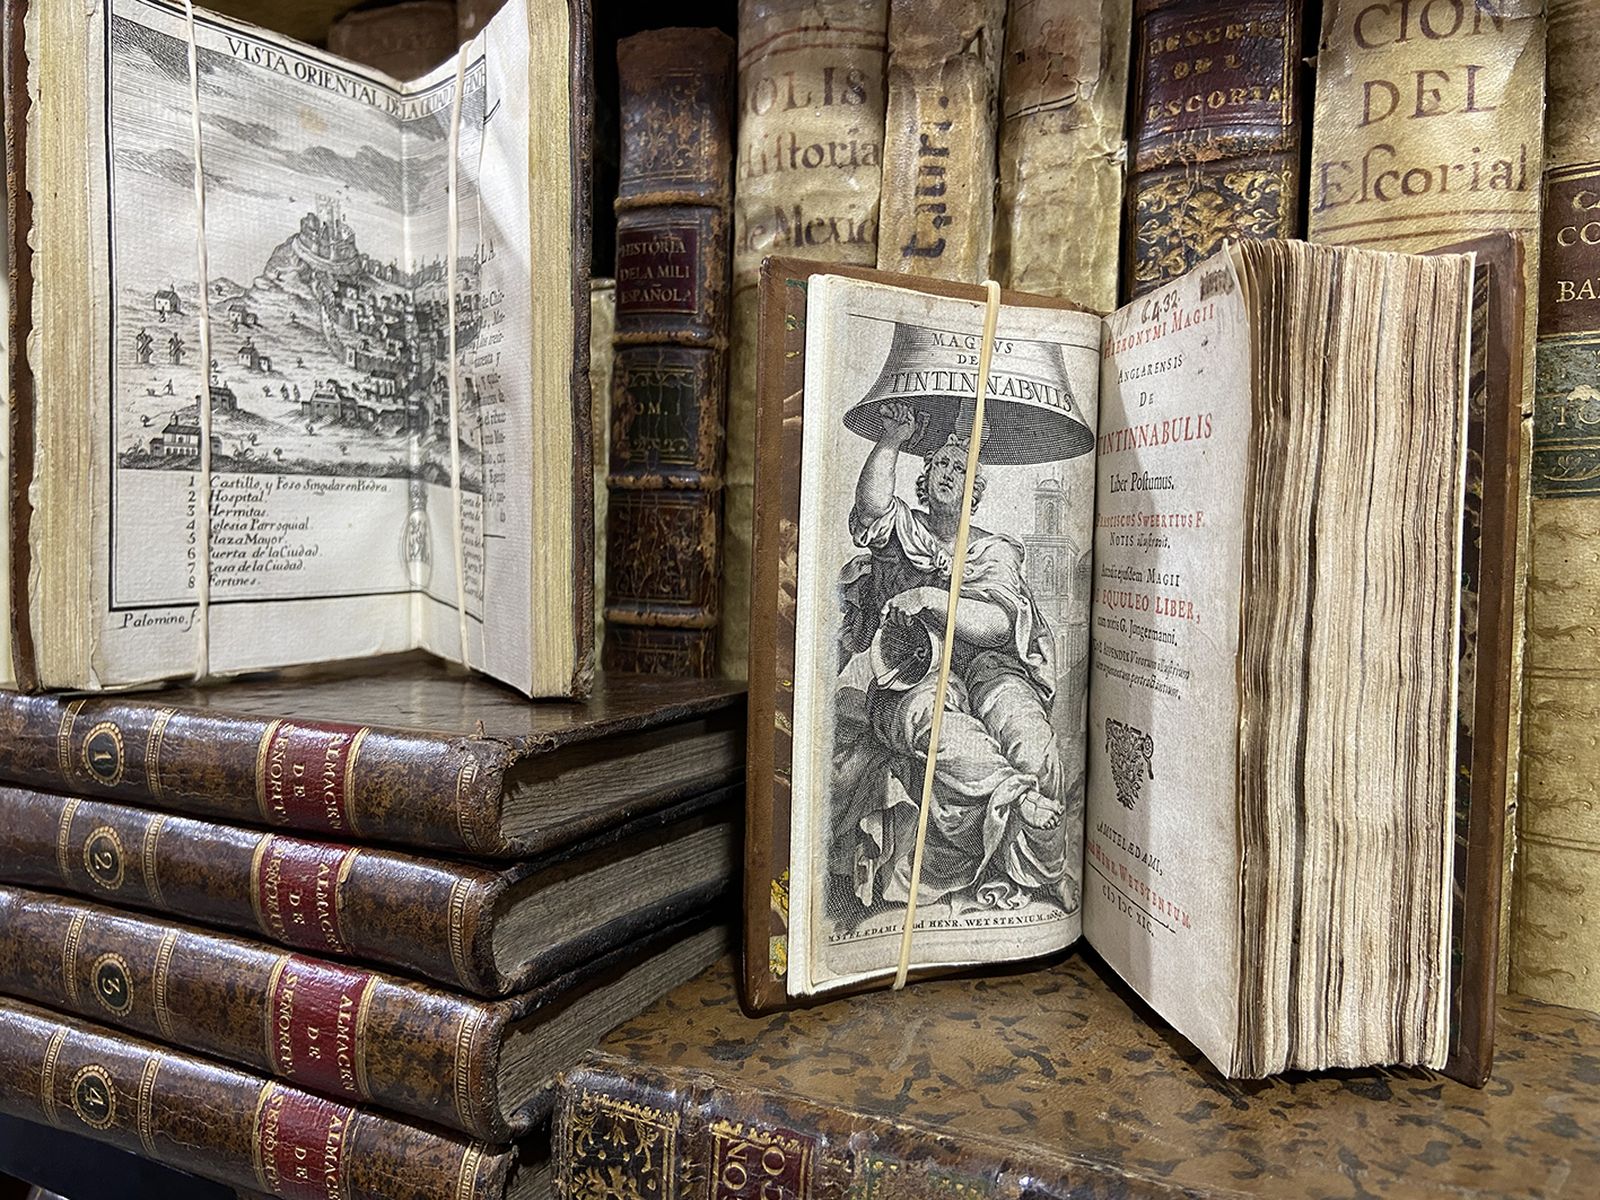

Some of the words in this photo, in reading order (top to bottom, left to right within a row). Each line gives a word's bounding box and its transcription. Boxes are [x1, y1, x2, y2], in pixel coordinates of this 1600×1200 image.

[225, 36, 290, 76] VISTA
[294, 61, 383, 109] ORIENTAL
[743, 67, 868, 116] OLIS
[1358, 65, 1496, 127] DEL
[1556, 277, 1600, 303] BA
[1171, 303, 1215, 334] MAGII
[931, 333, 1014, 354] MAGVS
[1139, 391, 1154, 408] DE
[635, 402, 669, 416] OM.
[188, 476, 195, 487] 1
[266, 480, 273, 496] y
[1110, 473, 1128, 493] Liber
[188, 490, 196, 502] 2
[186, 504, 196, 517] 3
[186, 519, 195, 530] 4
[186, 531, 196, 544] 5
[1109, 532, 1134, 547] NOTIS
[187, 547, 196, 559] 6
[252, 547, 265, 559] de
[187, 561, 196, 574] 7
[188, 575, 196, 589] 8
[1147, 568, 1180, 587] MAGII
[1155, 596, 1200, 625] LIBER,
